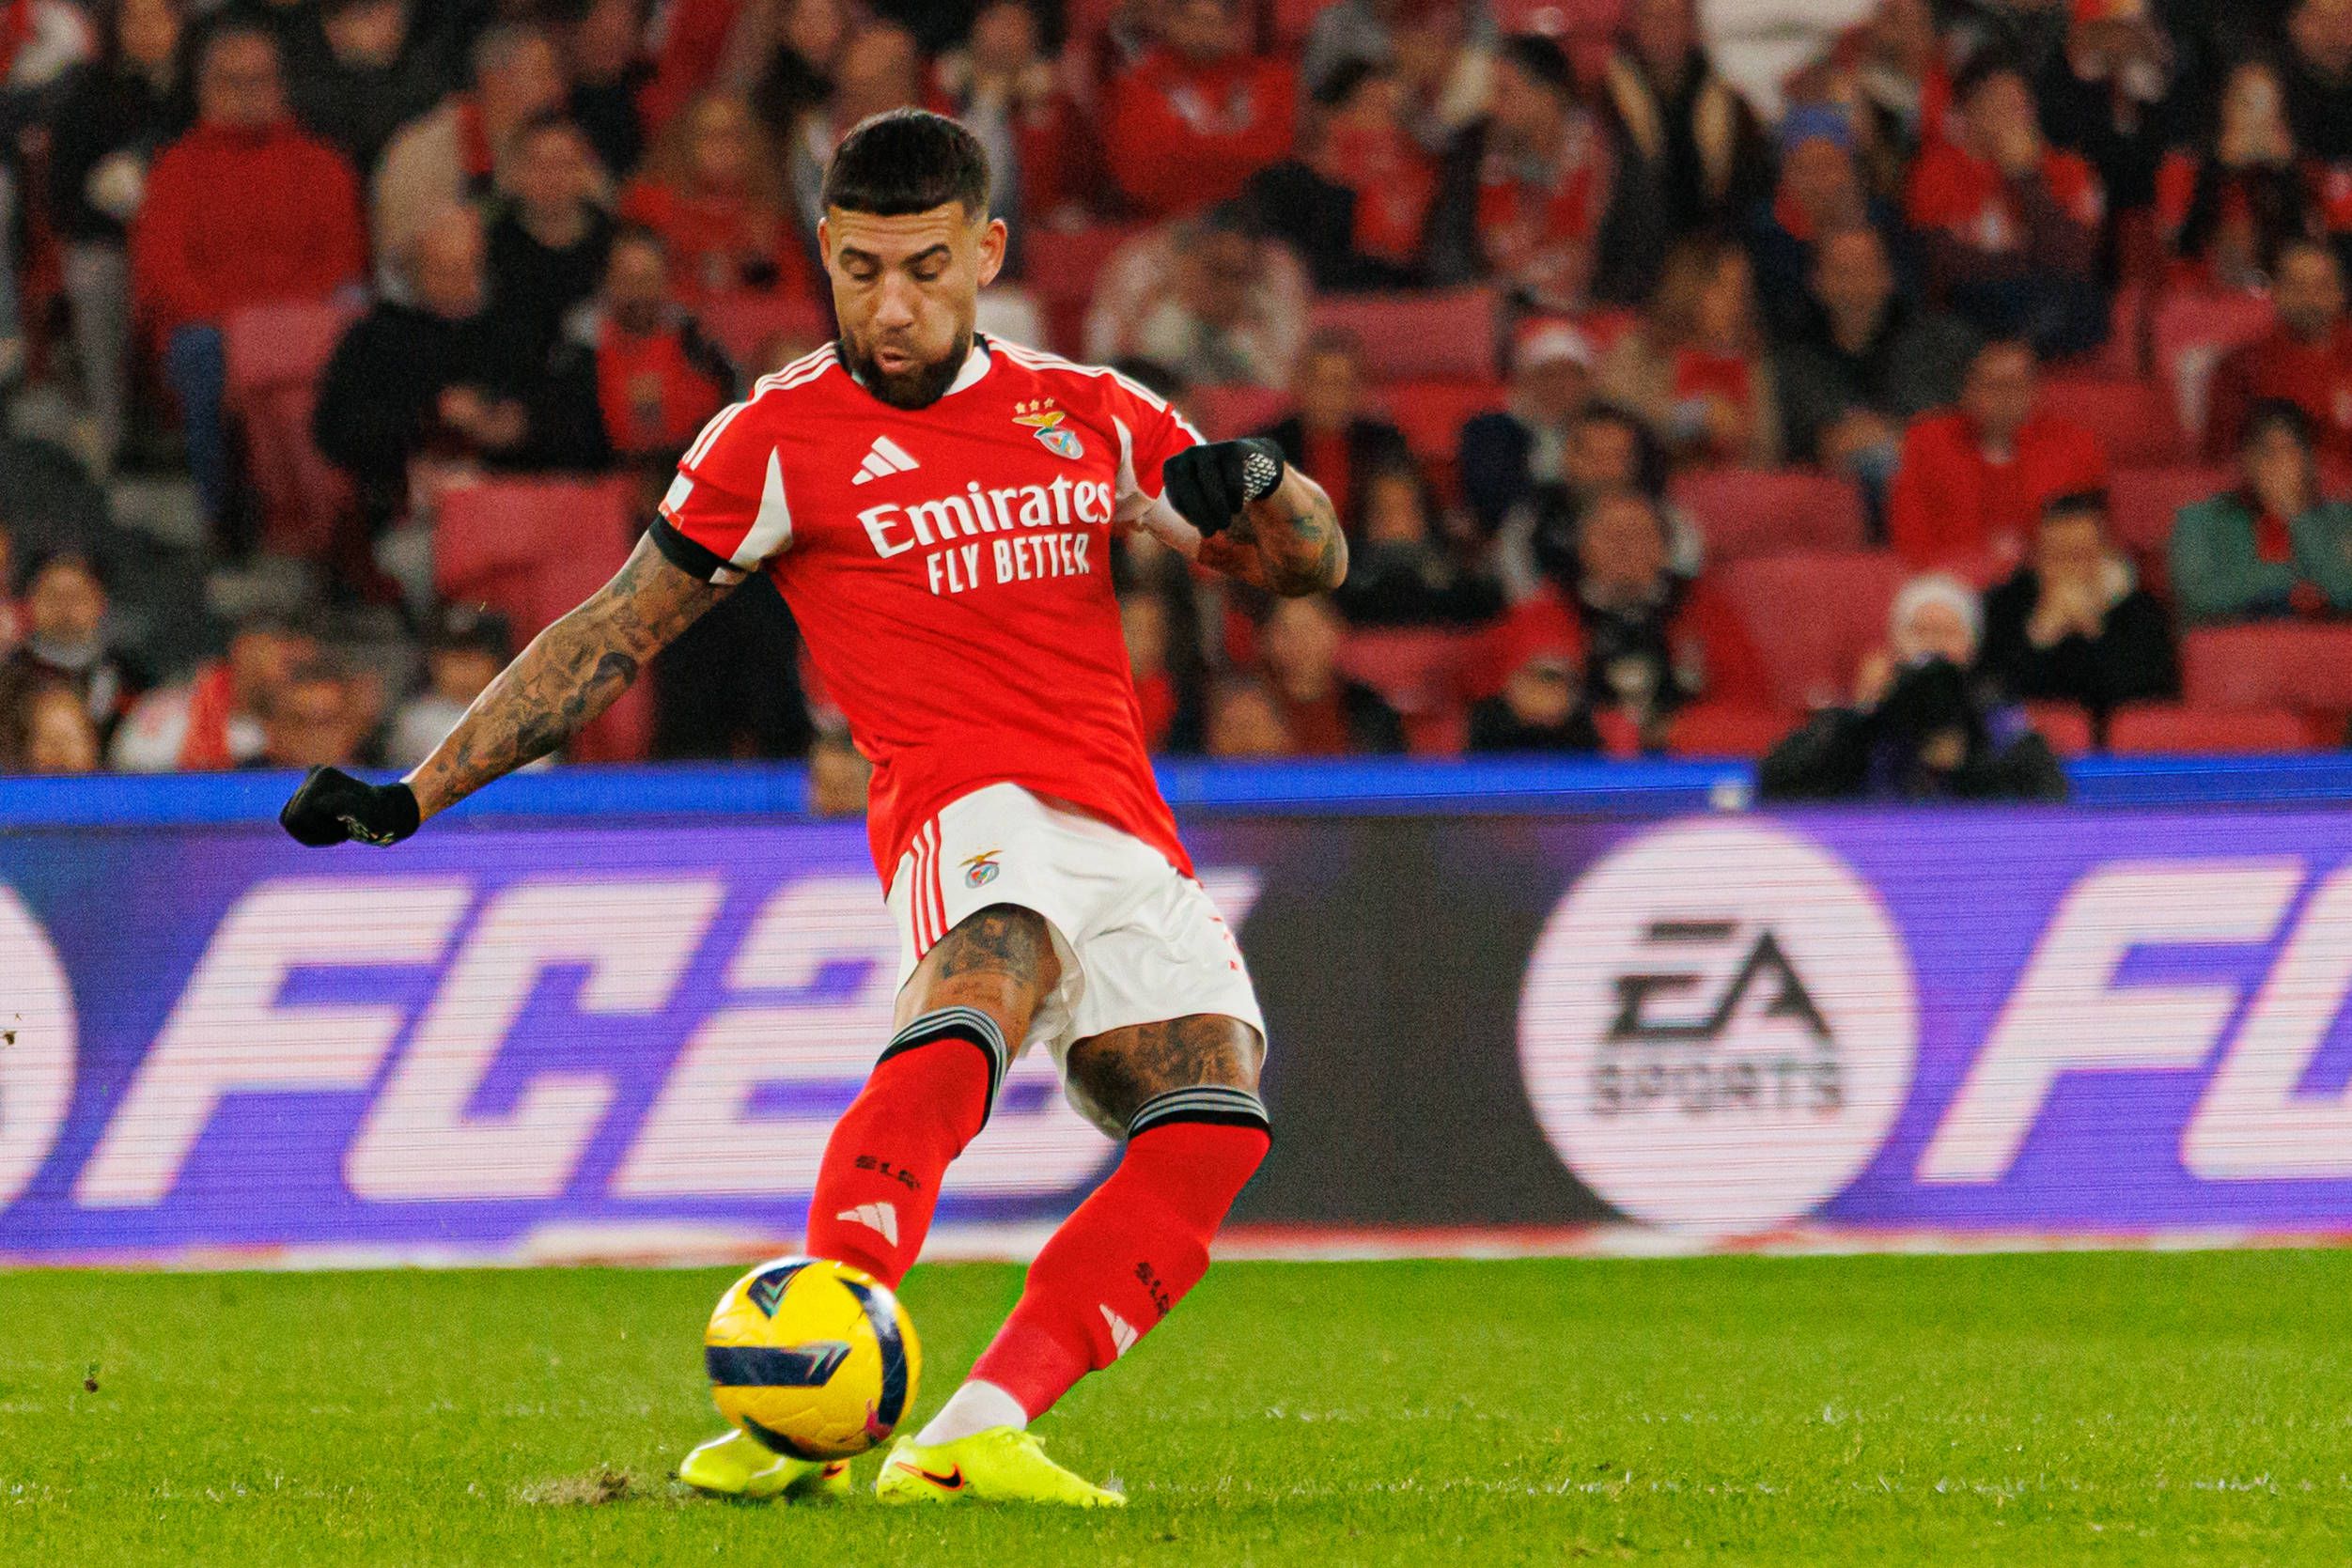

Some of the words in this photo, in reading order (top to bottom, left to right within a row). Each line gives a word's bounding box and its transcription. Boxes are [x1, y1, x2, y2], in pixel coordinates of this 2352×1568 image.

[856, 474, 1112, 559] Emirates
[927, 543, 979, 595] FLY
[992, 533, 1091, 584] BETTER
[1602, 921, 1832, 1040] EA
[1590, 1058, 1845, 1114] SPORTS
